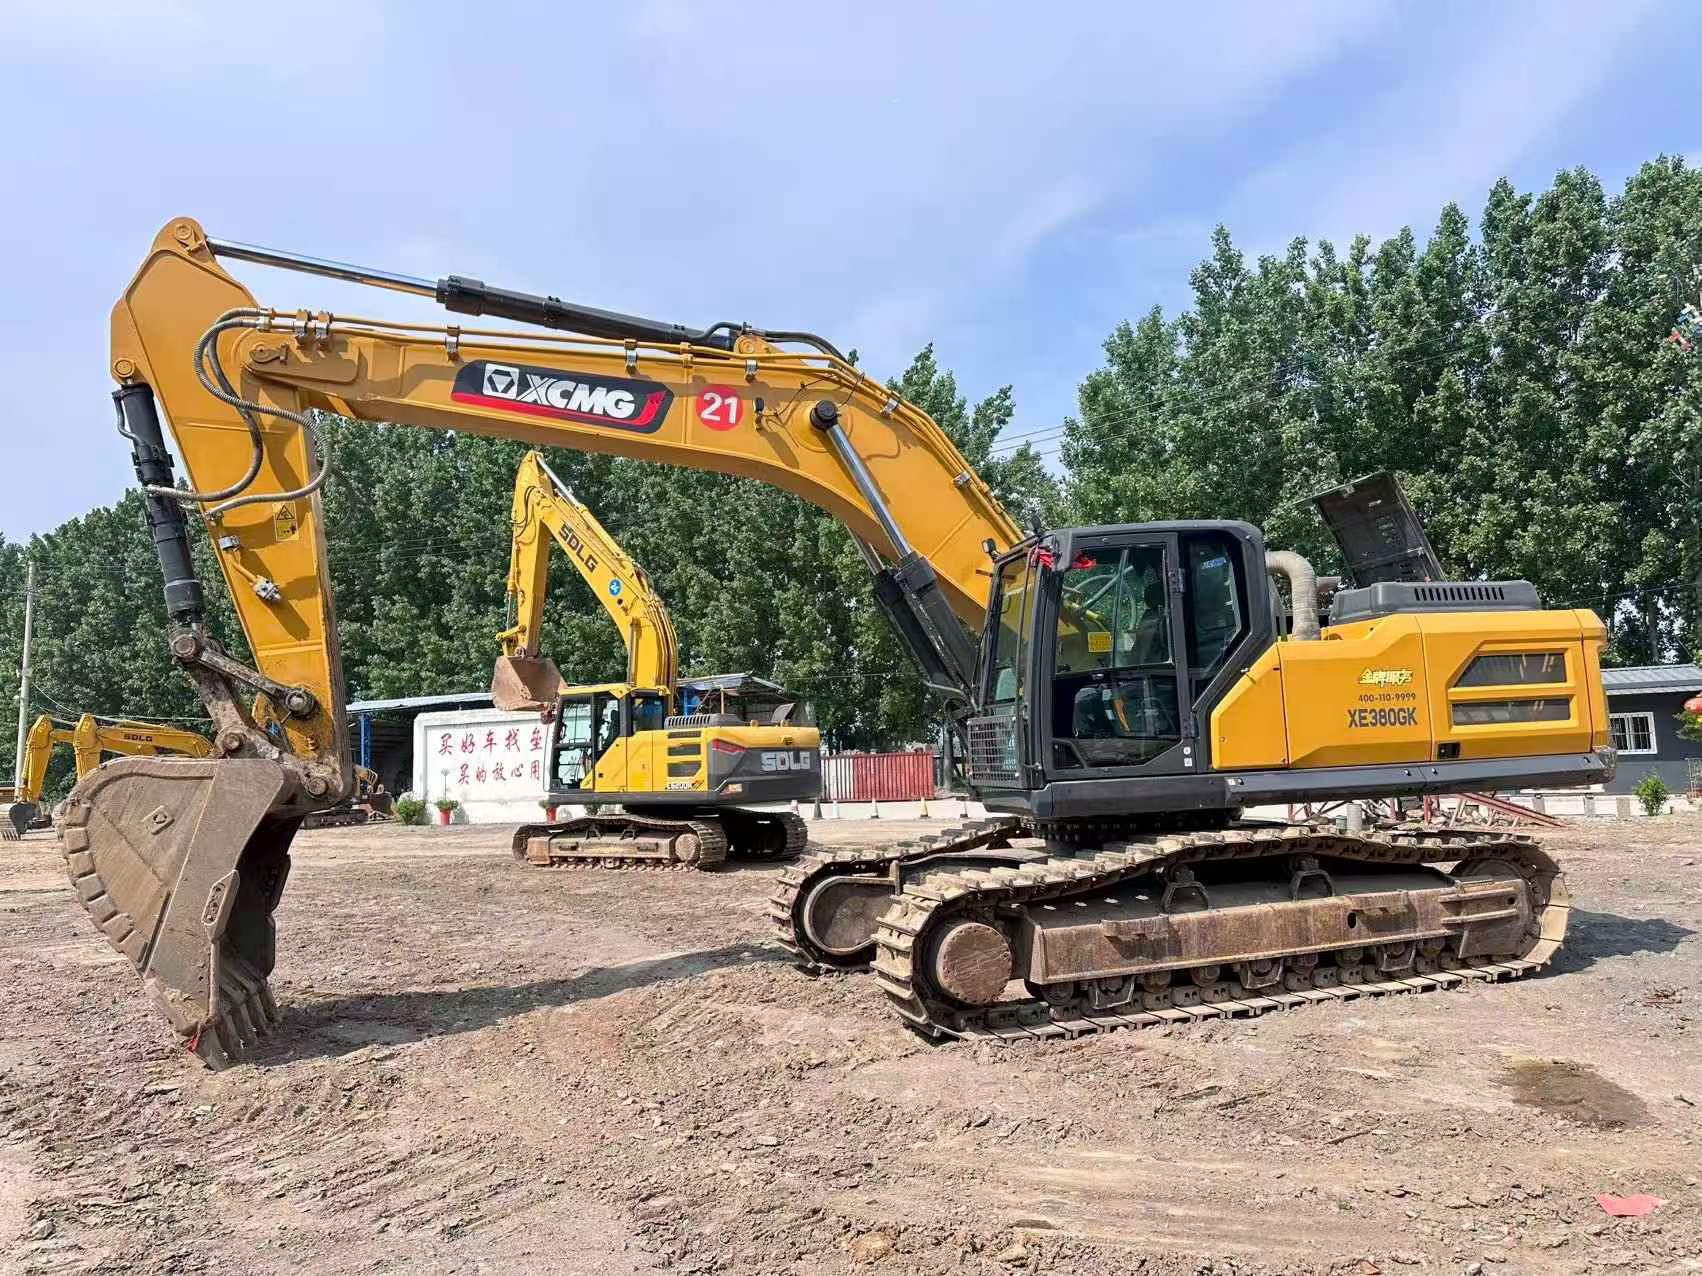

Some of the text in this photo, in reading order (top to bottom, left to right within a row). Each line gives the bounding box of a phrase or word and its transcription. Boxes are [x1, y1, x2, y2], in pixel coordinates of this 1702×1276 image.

[517, 374, 635, 419] XCMG
[701, 392, 738, 425] 21
[559, 523, 598, 573] SDLG
[1358, 692, 1416, 702] 400-110-9999
[1347, 707, 1419, 728] XE380GK
[123, 733, 153, 742] SDLG
[760, 751, 811, 772] SDLG
